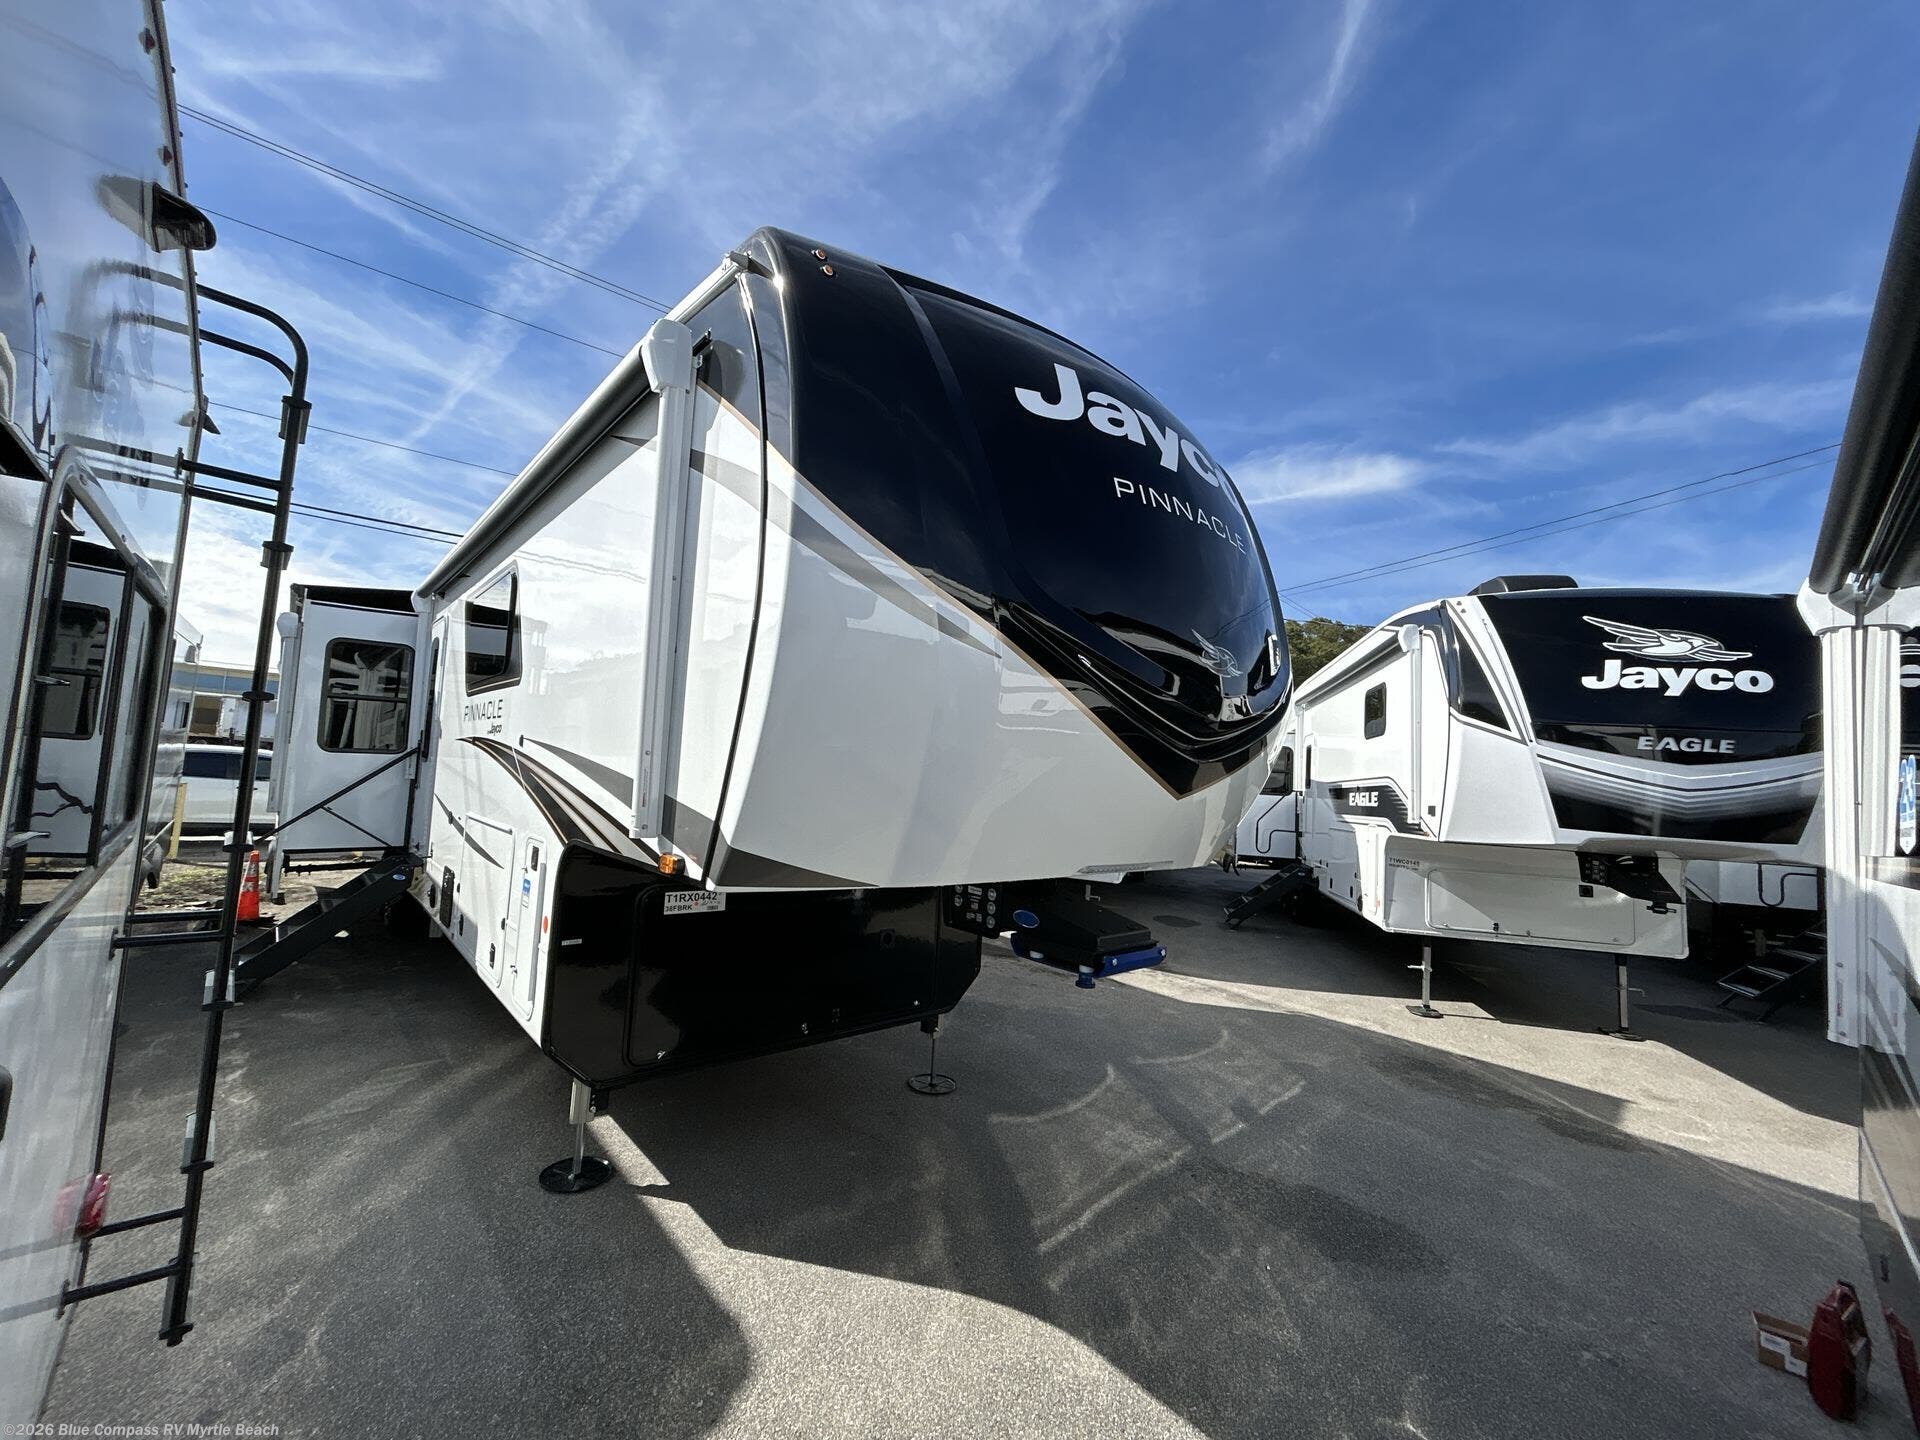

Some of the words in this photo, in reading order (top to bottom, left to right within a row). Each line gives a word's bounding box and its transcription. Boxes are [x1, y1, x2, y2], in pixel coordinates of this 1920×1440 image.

[1113, 476, 1247, 555] PINNACLE
[1581, 659, 1775, 697] Jayco
[463, 699, 504, 721] PINNACLE
[1637, 736, 1736, 754] EAGLE
[1349, 791, 1379, 807] EAGLE
[666, 891, 718, 903] T1RX0442
